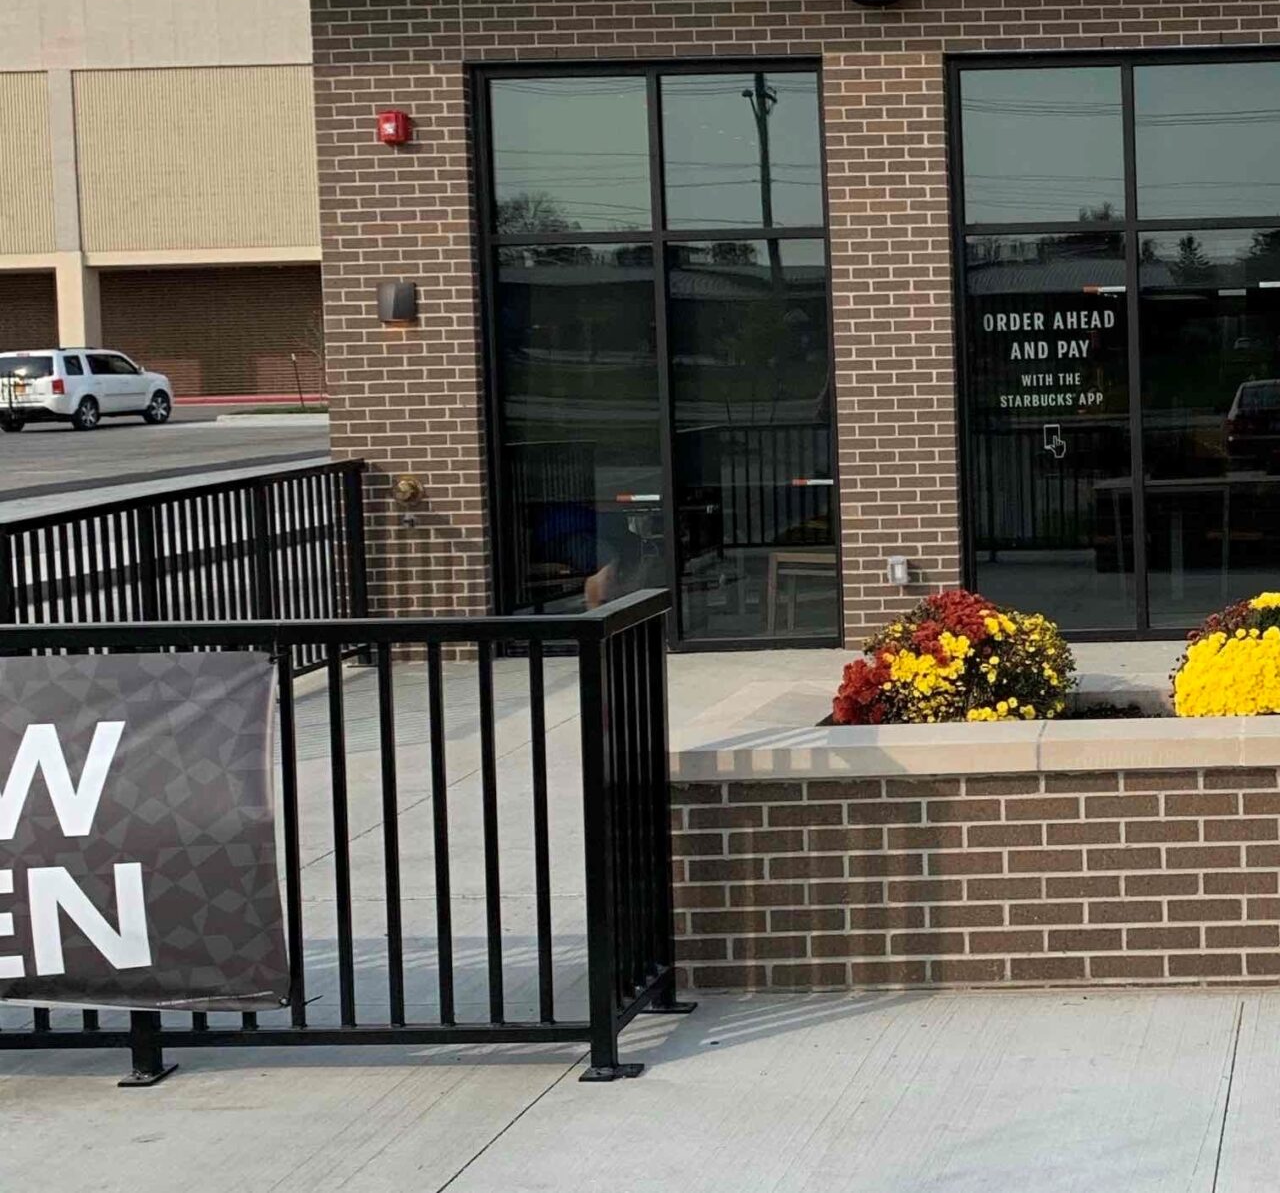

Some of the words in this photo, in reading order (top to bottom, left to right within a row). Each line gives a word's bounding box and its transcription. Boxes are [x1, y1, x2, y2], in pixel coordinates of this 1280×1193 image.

[983, 312, 1044, 332] ORDER
[1053, 310, 1115, 330] AHEAD
[1010, 341, 1049, 360] AND
[1057, 339, 1089, 359] PAY
[1021, 374, 1054, 387] WITH
[1058, 373, 1081, 386] THE
[1078, 392, 1104, 405] APP
